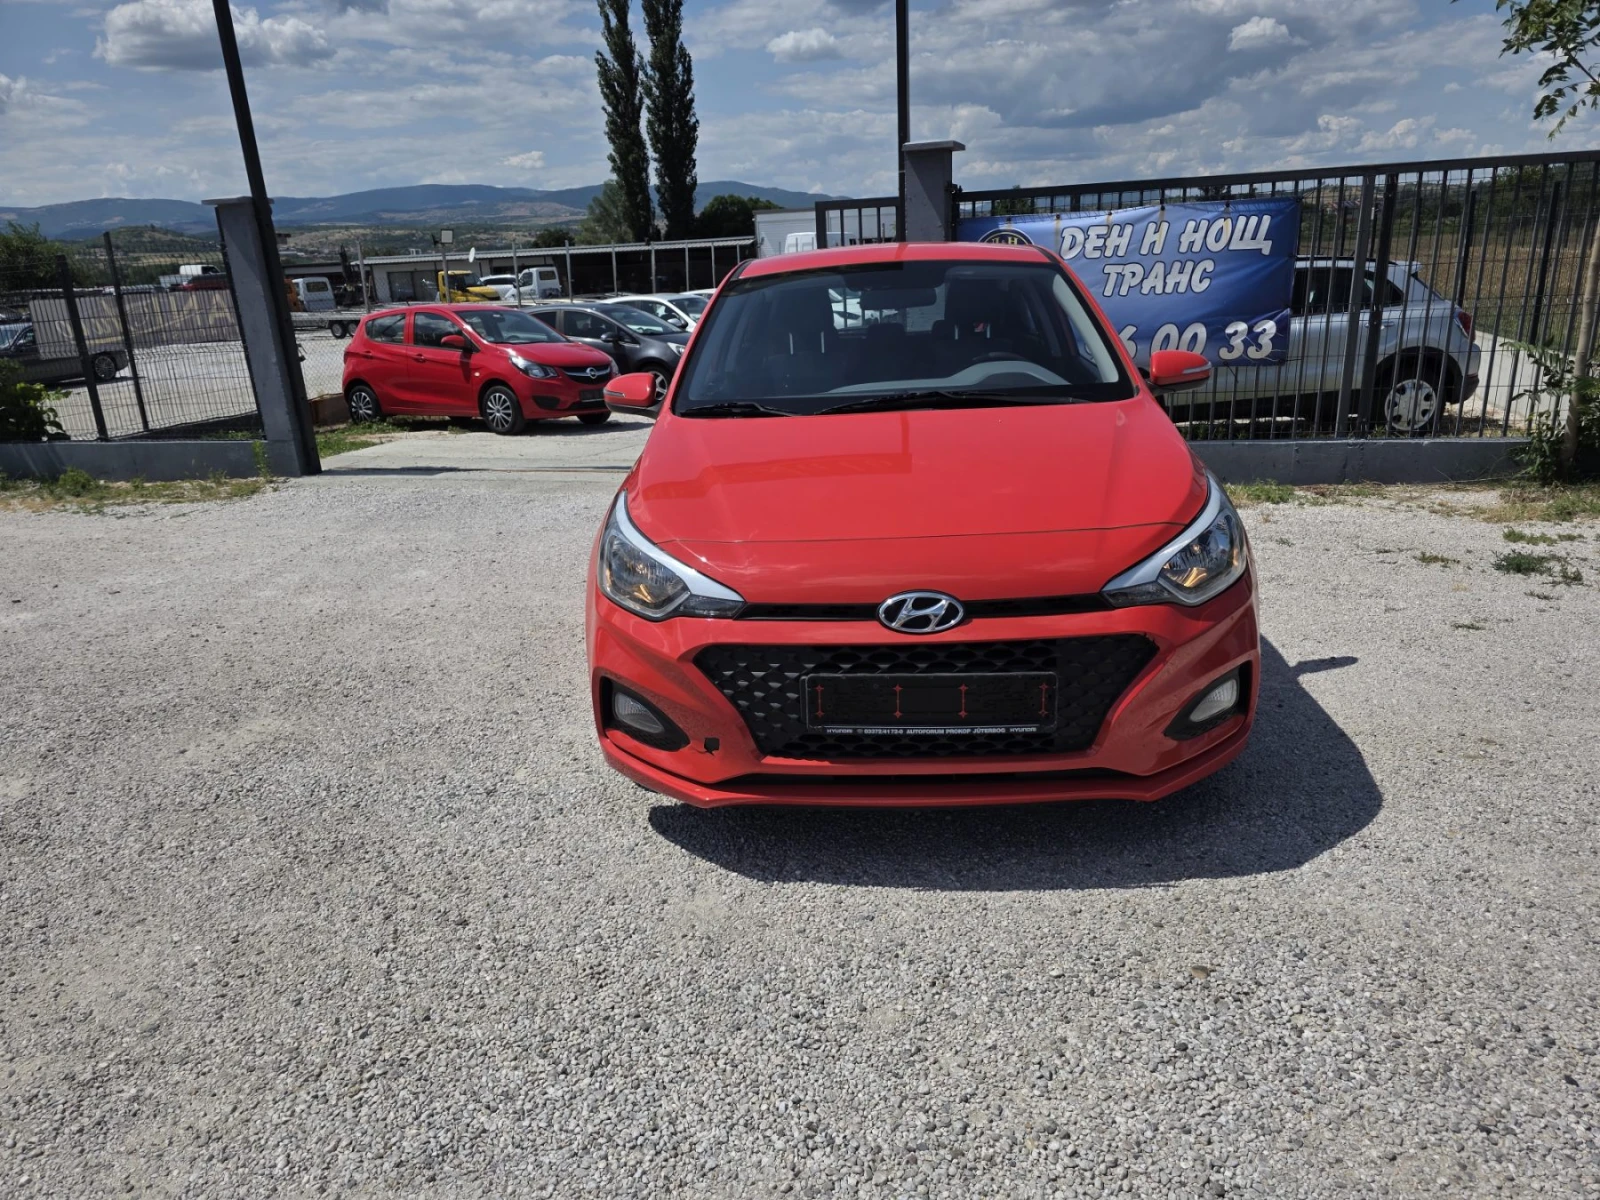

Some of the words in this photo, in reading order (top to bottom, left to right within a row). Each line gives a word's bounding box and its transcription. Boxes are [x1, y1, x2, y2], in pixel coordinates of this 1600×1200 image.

[1178, 214, 1273, 256] НОЩ
[1102, 259, 1215, 297] ТРАНС
[1219, 320, 1277, 360] 33
[906, 728, 945, 736] AUTOFORUM
